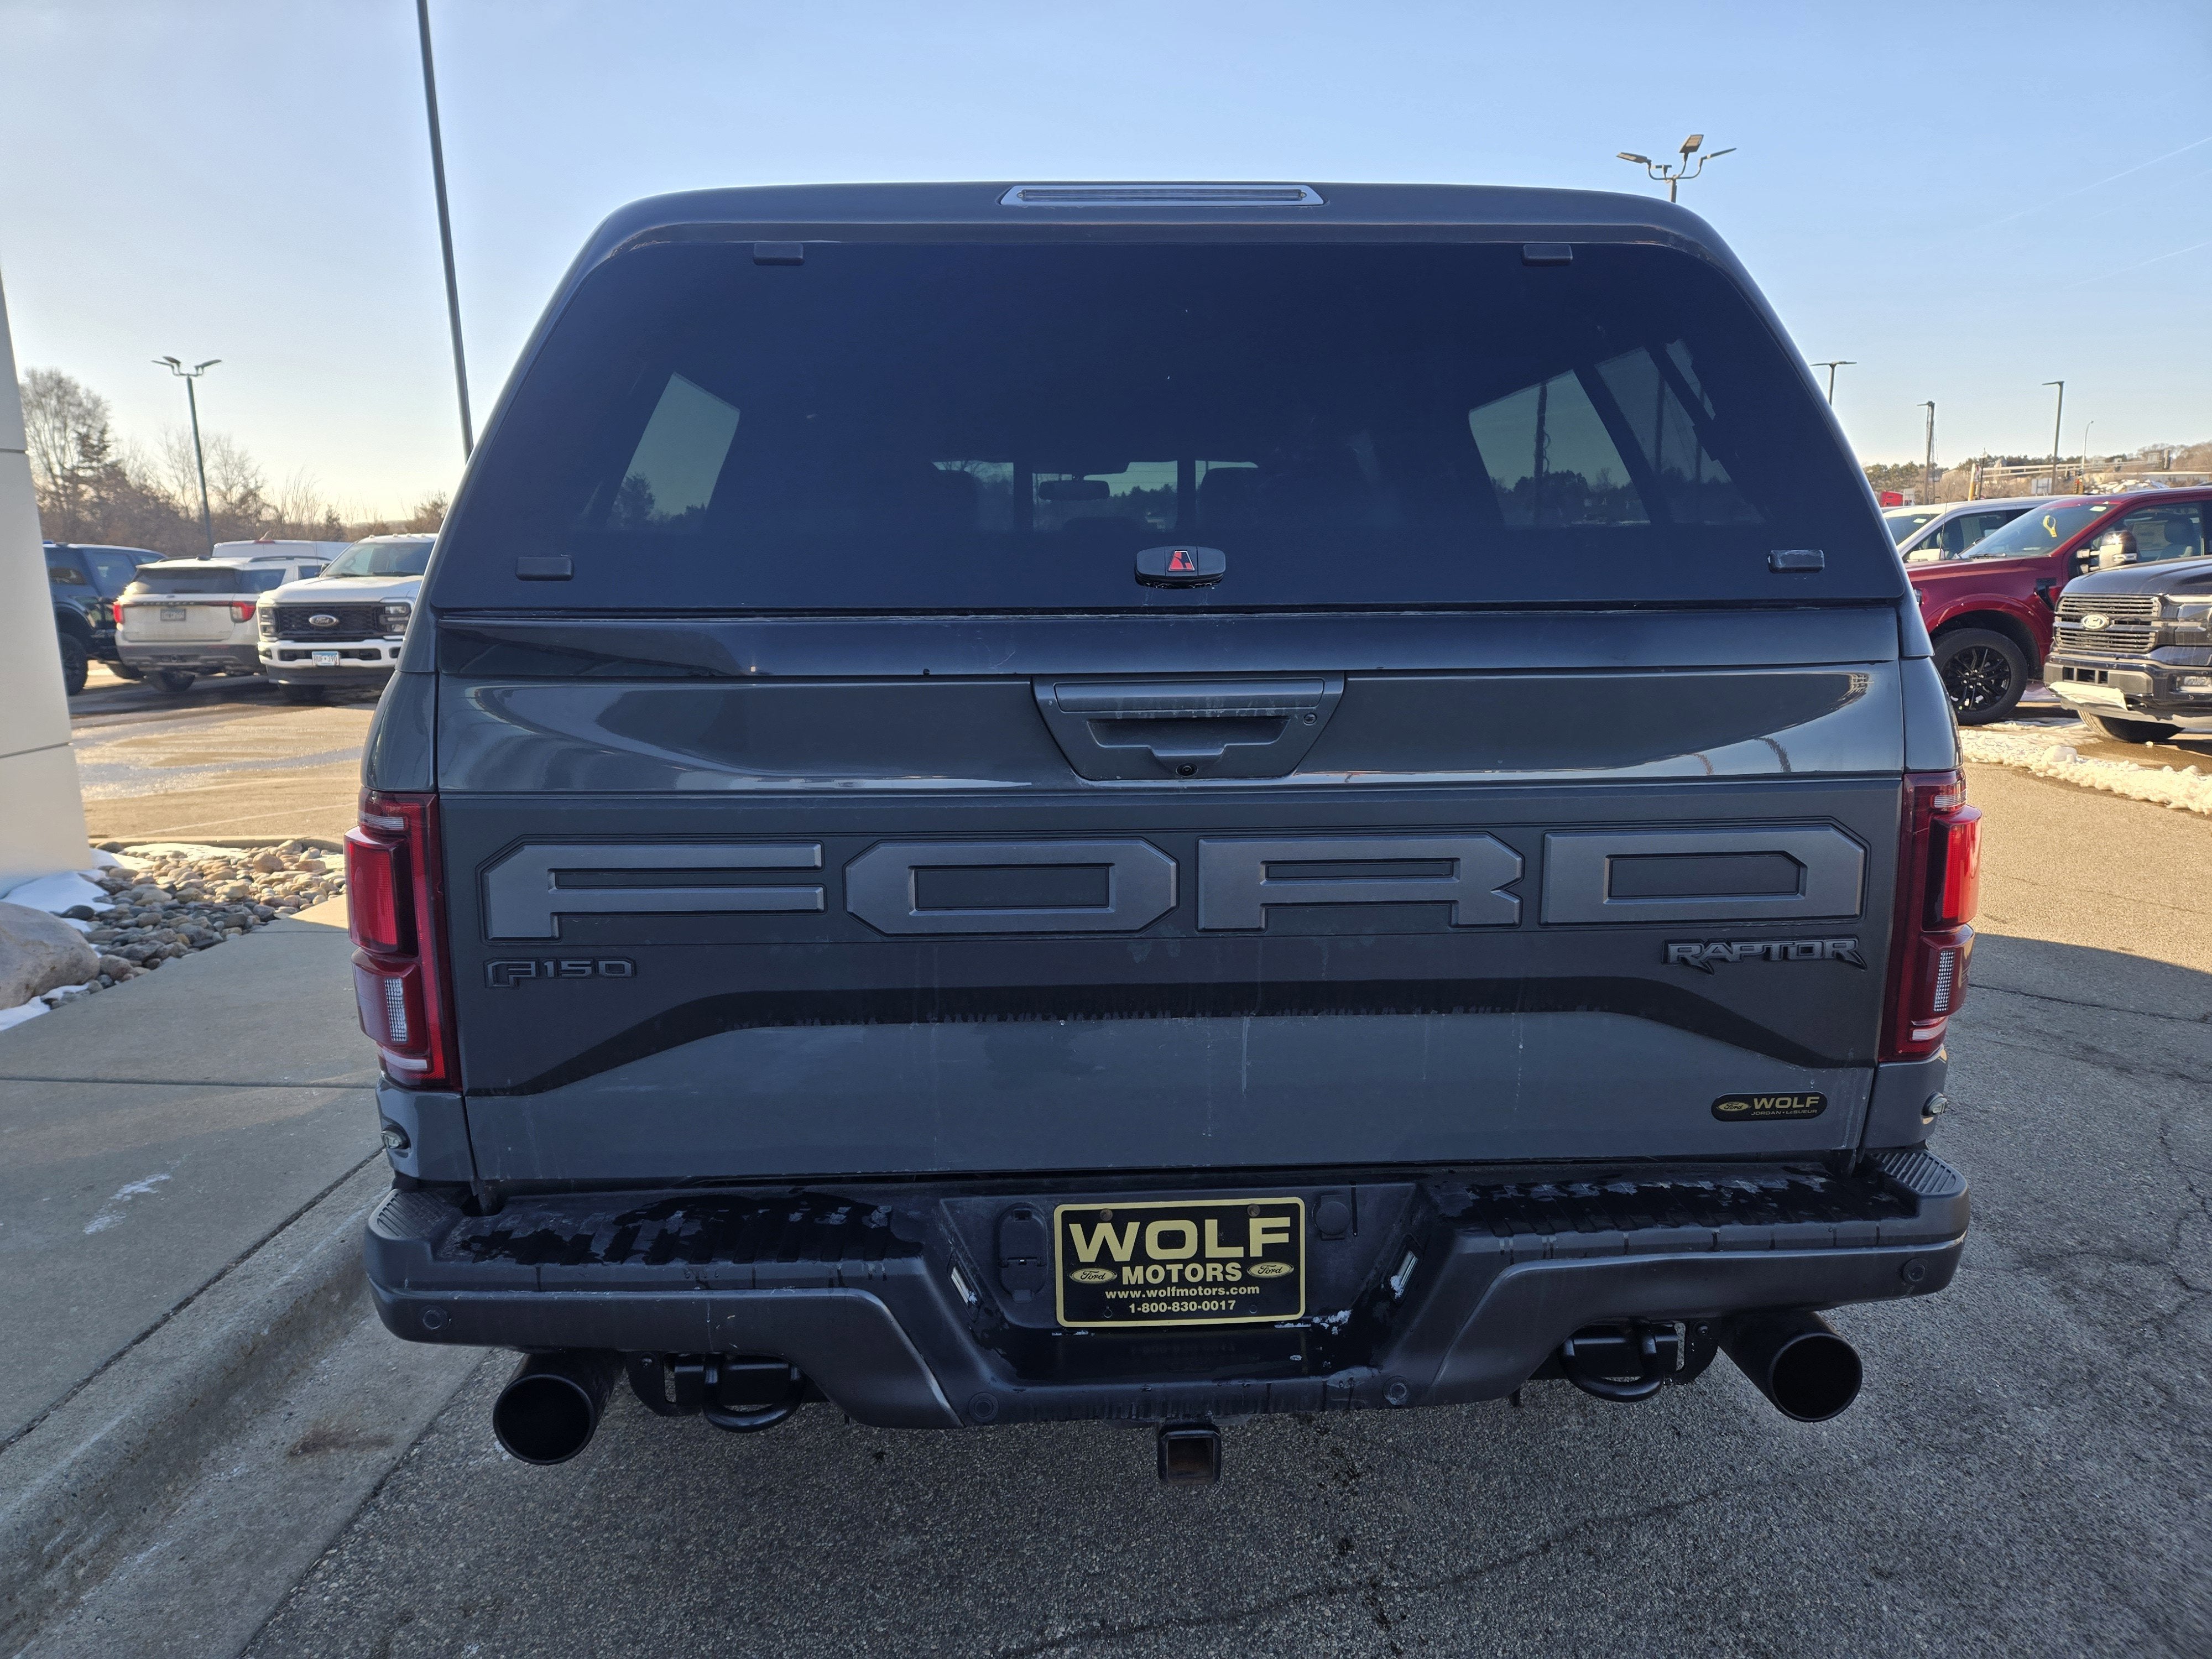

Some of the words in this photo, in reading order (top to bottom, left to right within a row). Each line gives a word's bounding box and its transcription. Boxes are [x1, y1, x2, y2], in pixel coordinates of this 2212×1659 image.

[483, 825, 1865, 938] FORD
[1664, 936, 1867, 974] RAPTOR
[1754, 1096, 1820, 1109] WOLF
[1069, 1217, 1291, 1262] WOLF
[1080, 1270, 1106, 1280] Ford
[1122, 1262, 1242, 1285] MOTORS
[1258, 1264, 1283, 1274] Ford
[1105, 1286, 1260, 1299] www.wolfmotors.com
[1129, 1300, 1236, 1313] 1-800-830-0017
